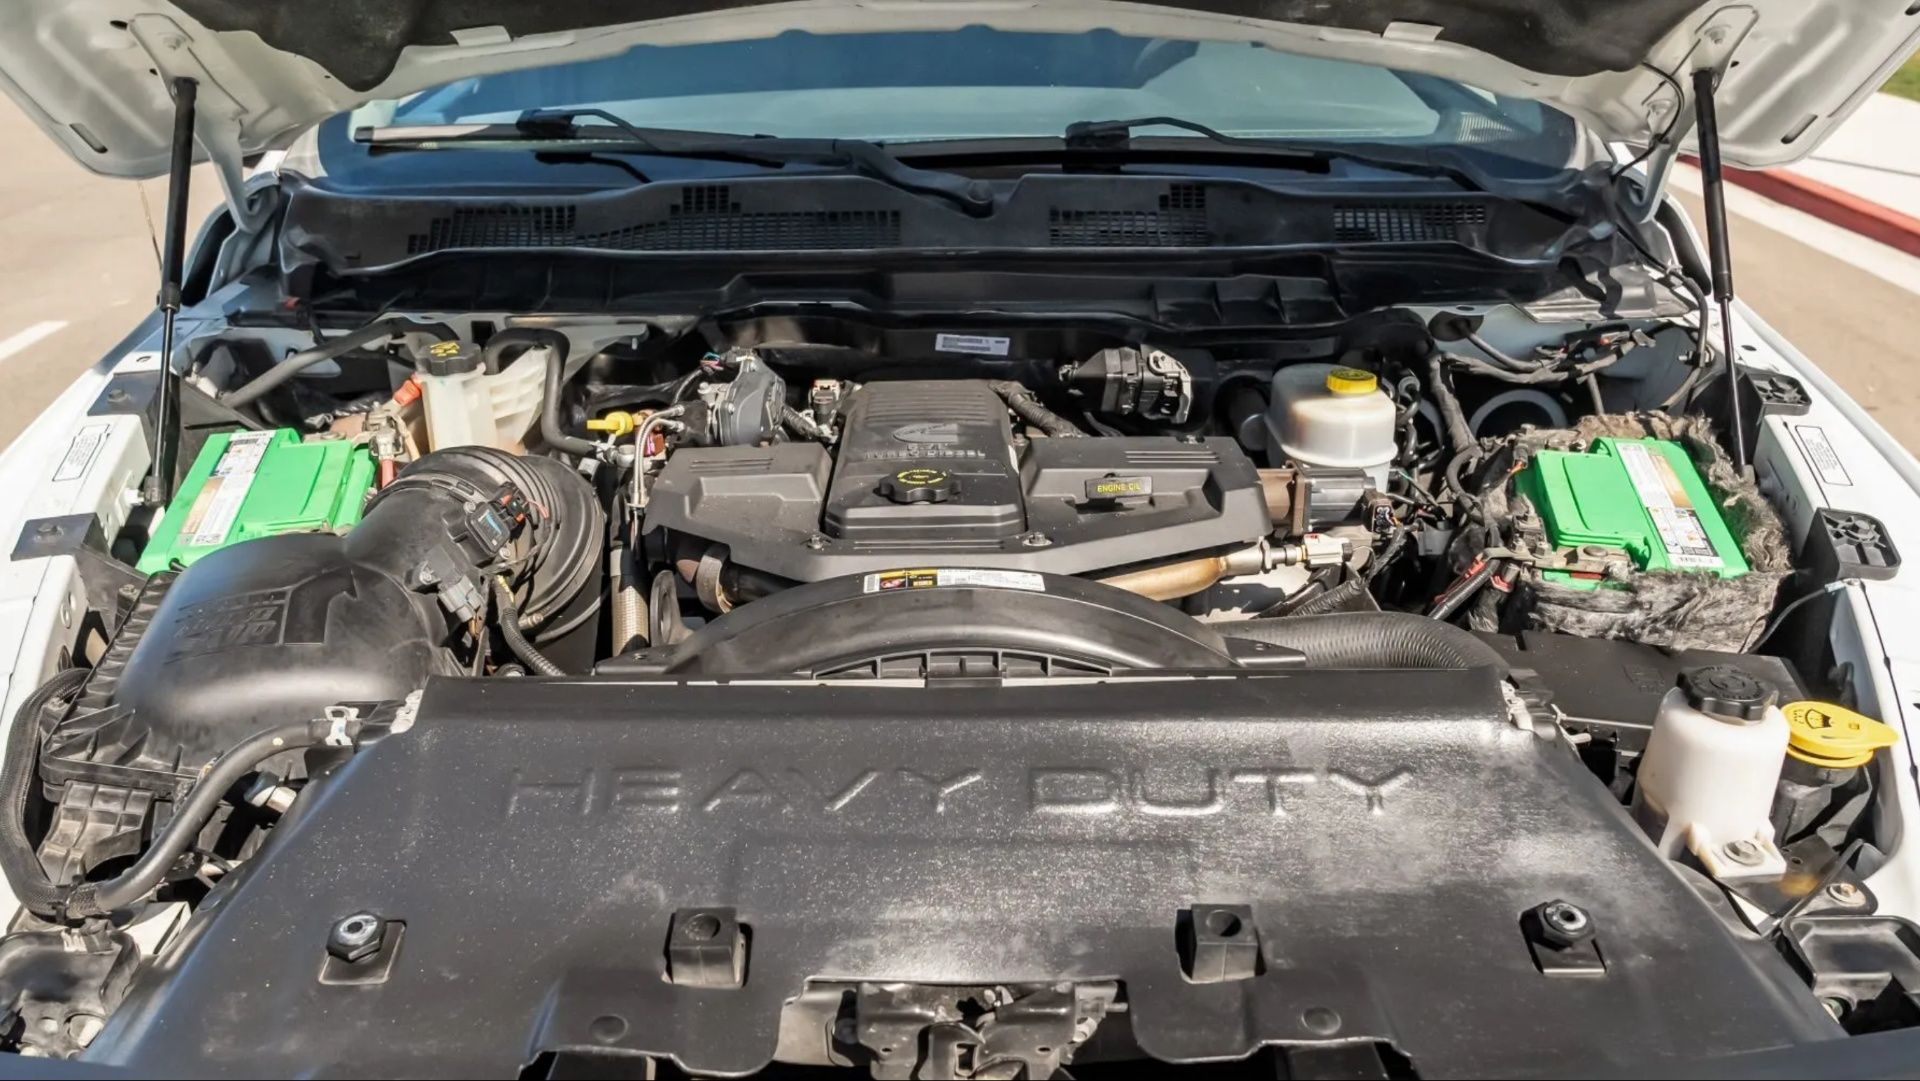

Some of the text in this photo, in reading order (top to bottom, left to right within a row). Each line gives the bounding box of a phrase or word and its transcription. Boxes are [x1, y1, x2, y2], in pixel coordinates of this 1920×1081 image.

[1097, 481, 1142, 493] ENGINE OIL
[507, 766, 1415, 816] HEAVY DUTY
